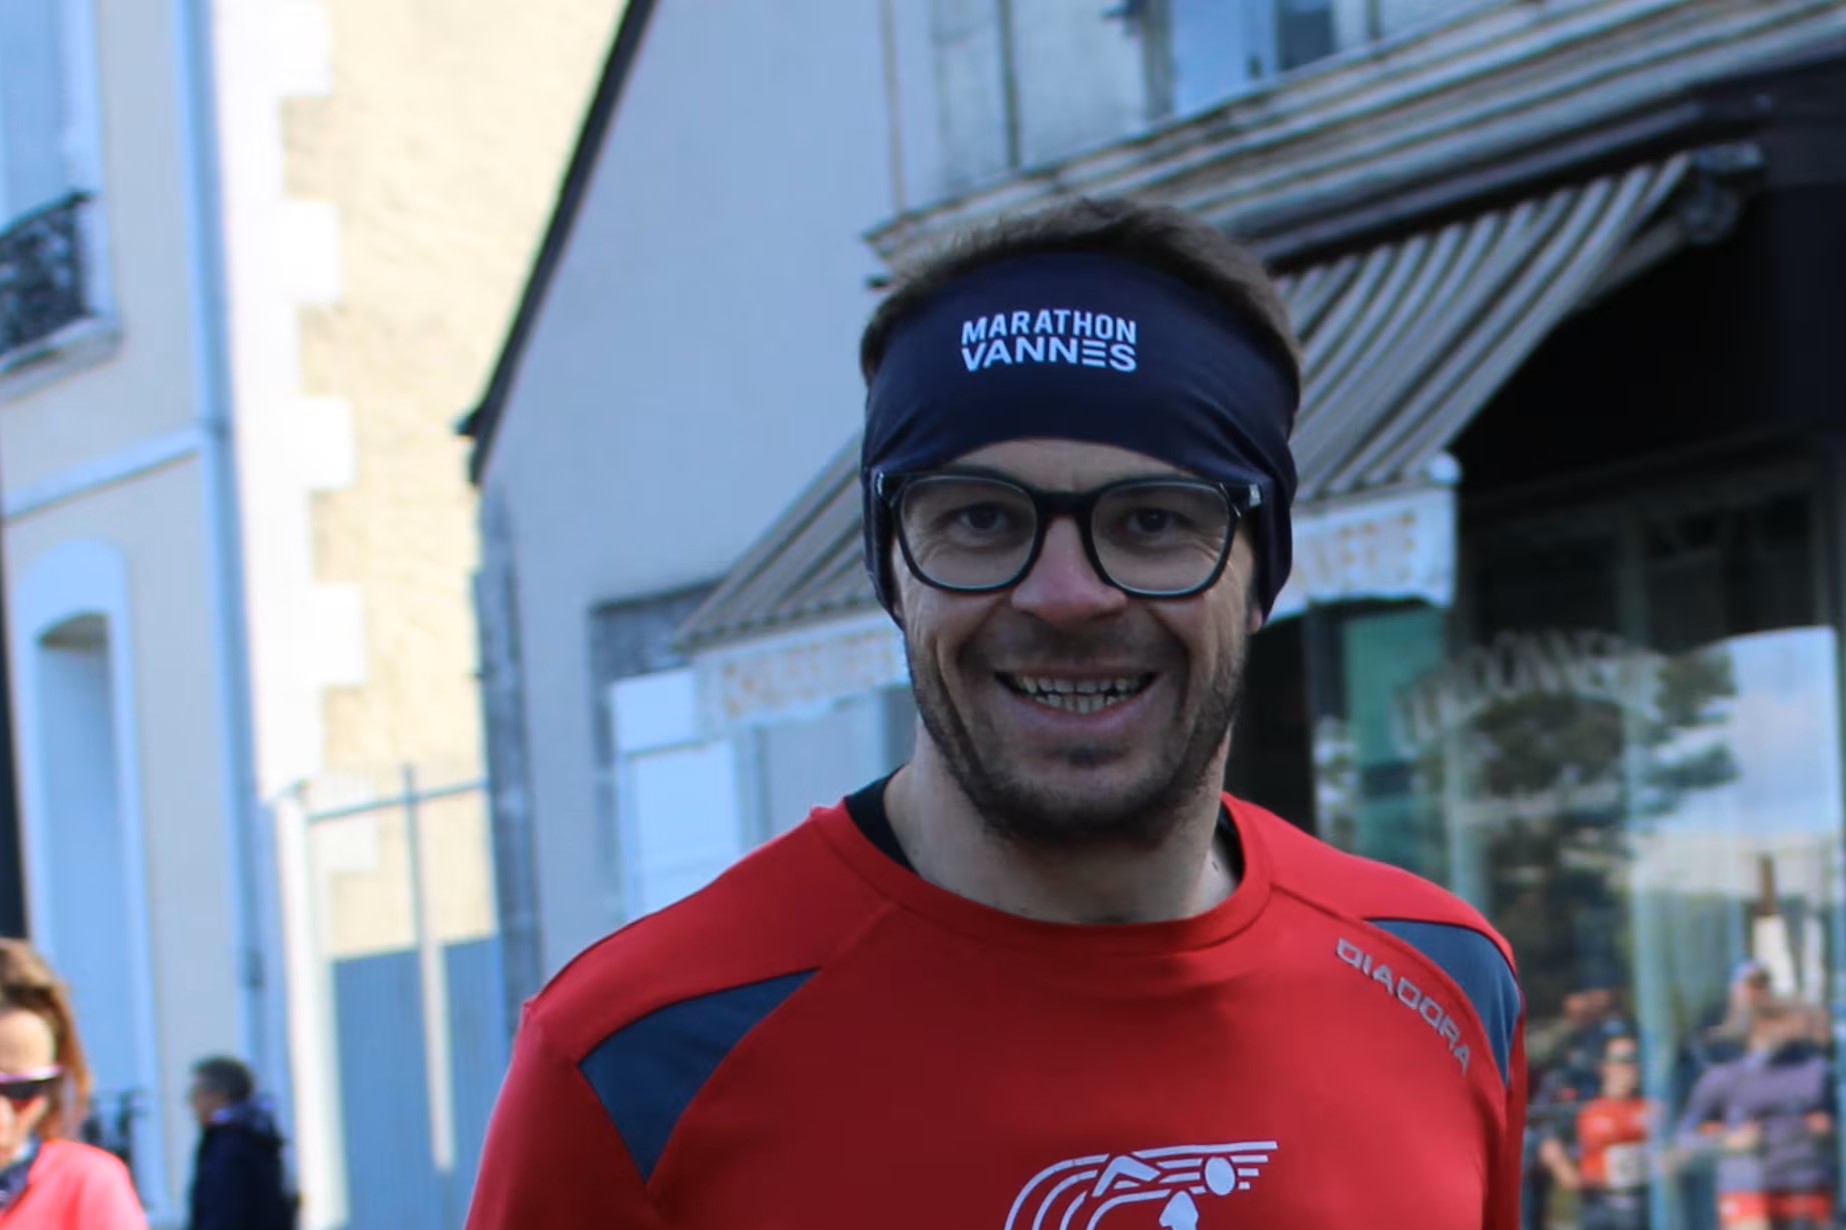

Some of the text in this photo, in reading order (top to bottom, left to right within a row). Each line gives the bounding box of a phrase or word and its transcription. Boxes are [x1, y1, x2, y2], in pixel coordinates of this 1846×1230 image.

[961, 309, 1137, 345] MARATHON
[961, 336, 1138, 373] VANNES
[1335, 937, 1471, 1077] DIADORA
